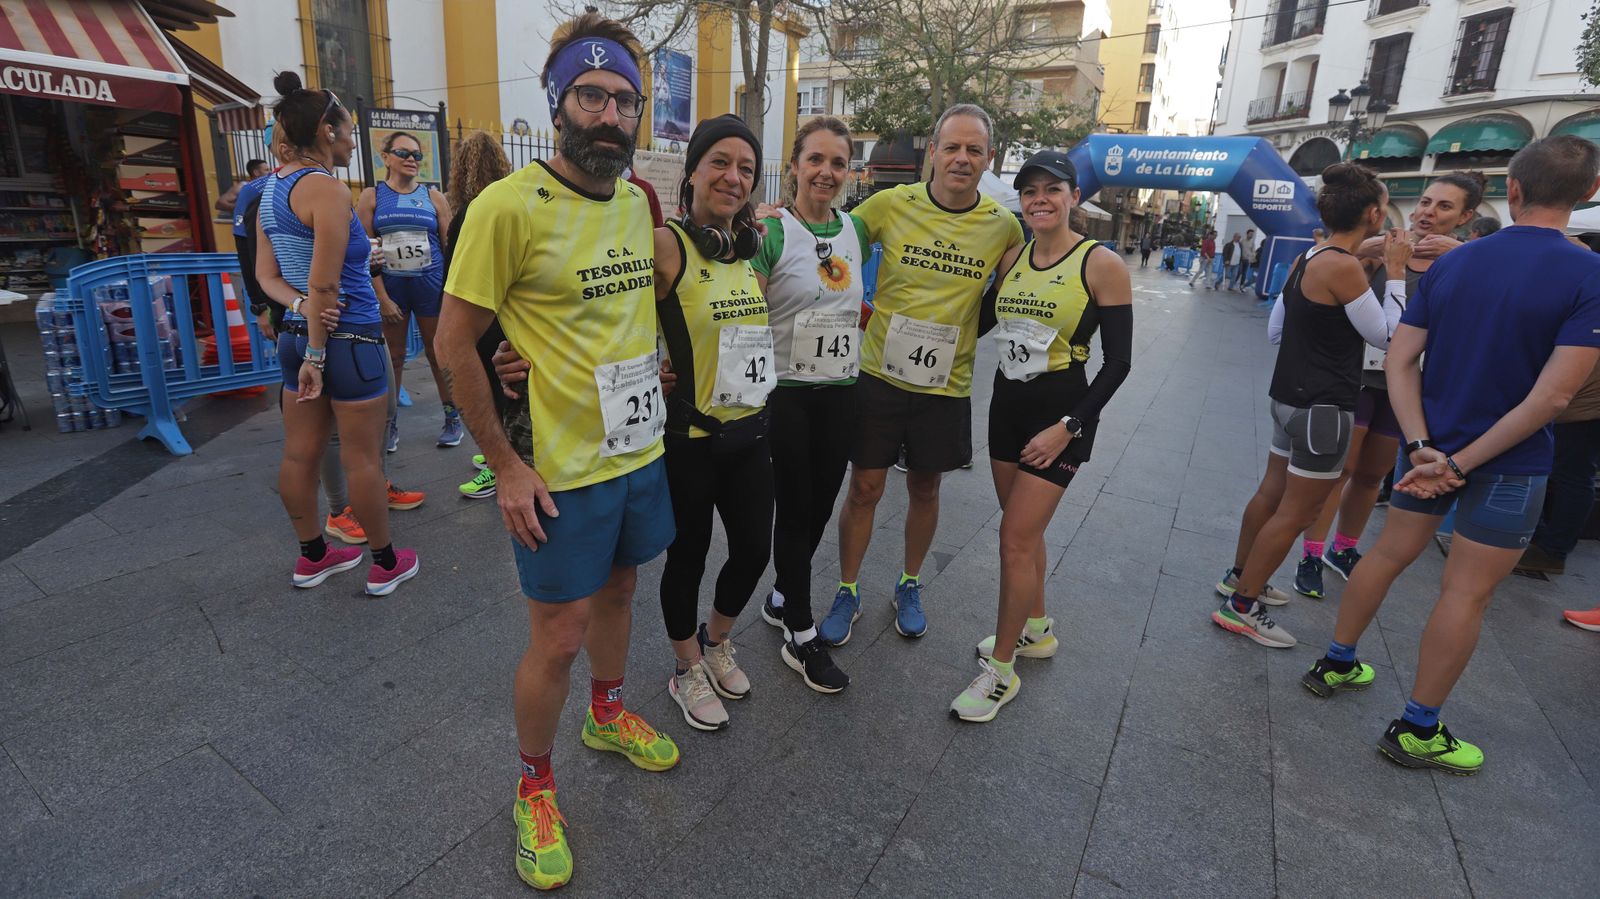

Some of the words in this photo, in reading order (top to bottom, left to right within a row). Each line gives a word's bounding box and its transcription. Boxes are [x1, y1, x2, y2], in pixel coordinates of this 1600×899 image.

[371, 111, 379, 119] LA
[381, 111, 400, 120] LÍNEA
[372, 119, 381, 127] DE
[391, 121, 431, 130] CONCEPCIÓN
[1127, 148, 1229, 161] Ayuntamiento
[1136, 163, 1152, 175] de
[1155, 164, 1171, 175] La
[1173, 164, 1215, 177] Línea
[1258, 183, 1269, 194] D
[1252, 203, 1292, 211] DEPORTES
[397, 245, 424, 260] 135
[607, 249, 619, 258] C.
[622, 247, 633, 256] A.
[934, 240, 945, 248] C.
[948, 243, 960, 251] A.
[902, 244, 986, 268] TESORILLO
[576, 257, 654, 283] TESORILLO
[900, 255, 983, 280] SECADERO
[998, 297, 1057, 310] TESORILLO
[997, 306, 1054, 319] SECADERO
[813, 334, 850, 358] 143
[1007, 339, 1031, 363] 33
[908, 345, 940, 369] 46
[745, 356, 766, 383] 42
[626, 385, 659, 426] 237
